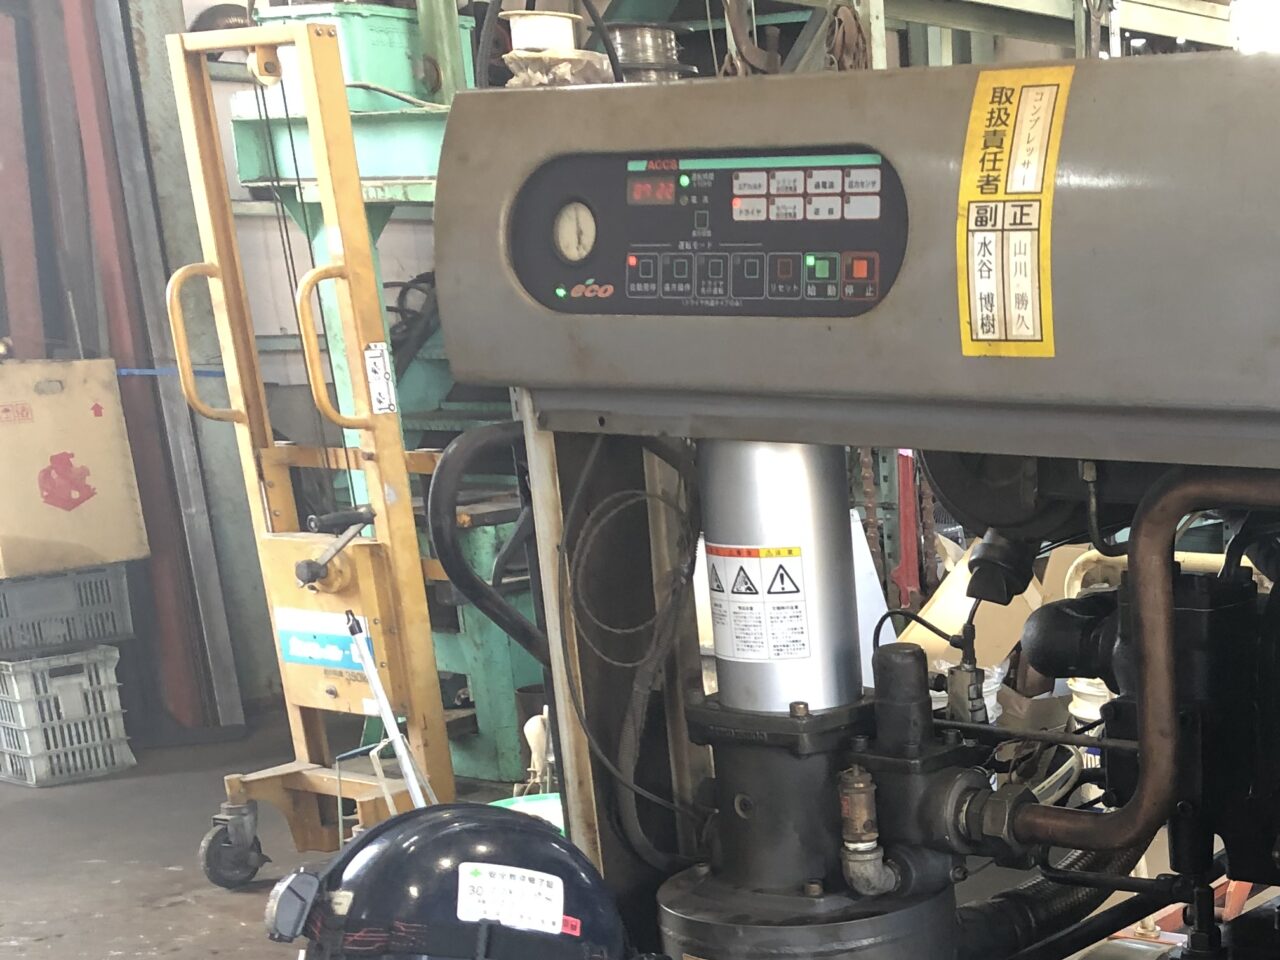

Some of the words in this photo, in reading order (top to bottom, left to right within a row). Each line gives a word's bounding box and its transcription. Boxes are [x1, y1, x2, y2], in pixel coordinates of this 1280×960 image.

[976, 85, 1015, 196] 取扱責任者
[974, 204, 998, 228] 副
[1009, 205, 1033, 227] 正
[976, 236, 993, 280] 水谷
[1013, 240, 1029, 279] 山川
[571, 284, 614, 298] eco
[978, 292, 996, 336] 博樹
